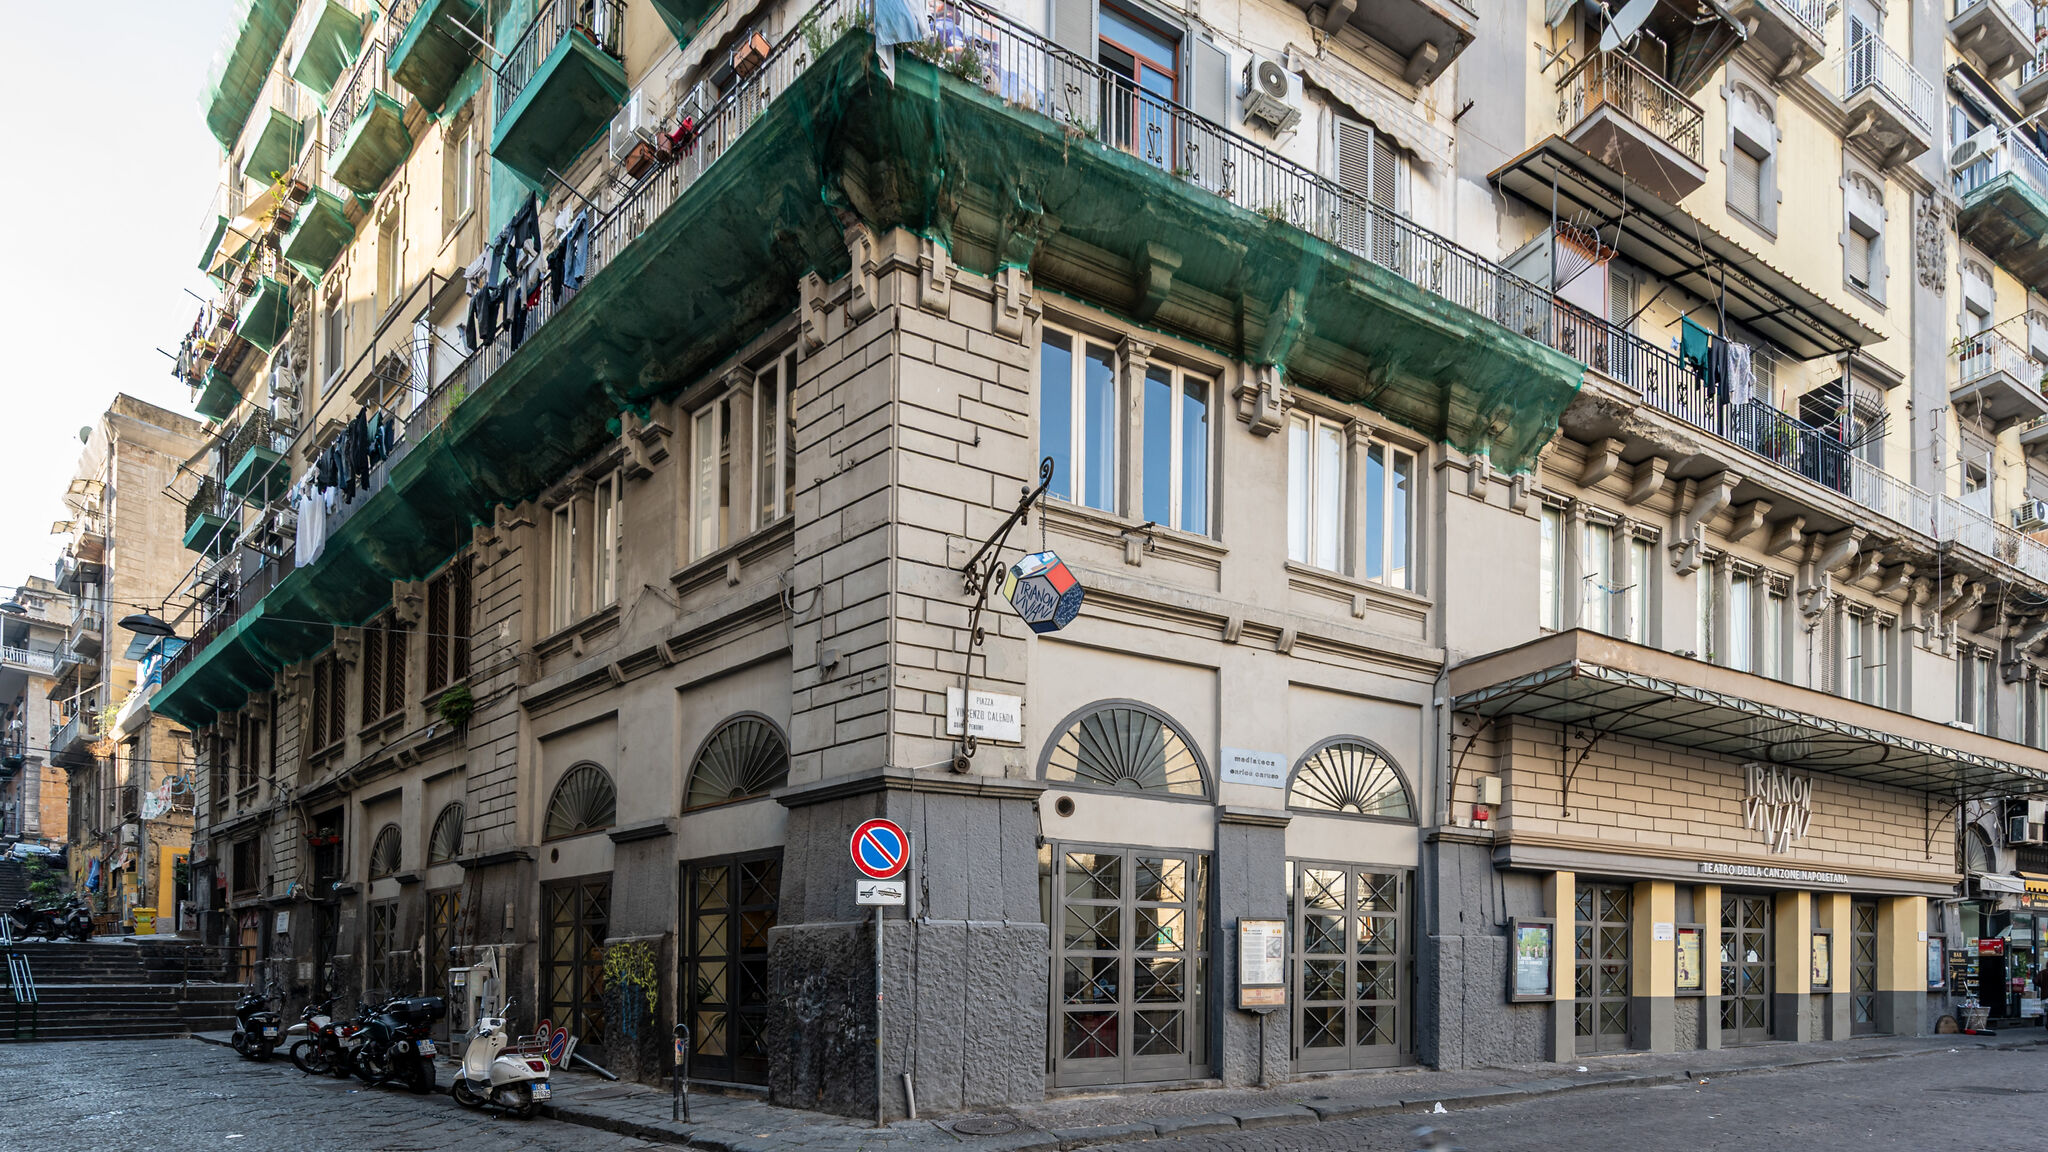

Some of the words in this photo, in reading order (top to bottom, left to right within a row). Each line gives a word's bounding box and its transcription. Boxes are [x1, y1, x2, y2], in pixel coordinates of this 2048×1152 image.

[1020, 580, 1058, 608] TRIANON
[1015, 593, 1053, 621] VIVIANI
[976, 696, 994, 706] PIAZZA
[955, 707, 985, 721] VINENZO
[987, 710, 1014, 724] CALENDA
[1234, 756, 1275, 767] mediateca
[1229, 768, 1253, 777] enrico
[1254, 772, 1279, 780] caruso
[1702, 862, 1737, 875] TEATRO
[1737, 865, 1761, 877] DELLA
[1763, 867, 1800, 880] CANZONE
[1801, 871, 1848, 883] NAPOLETANA
